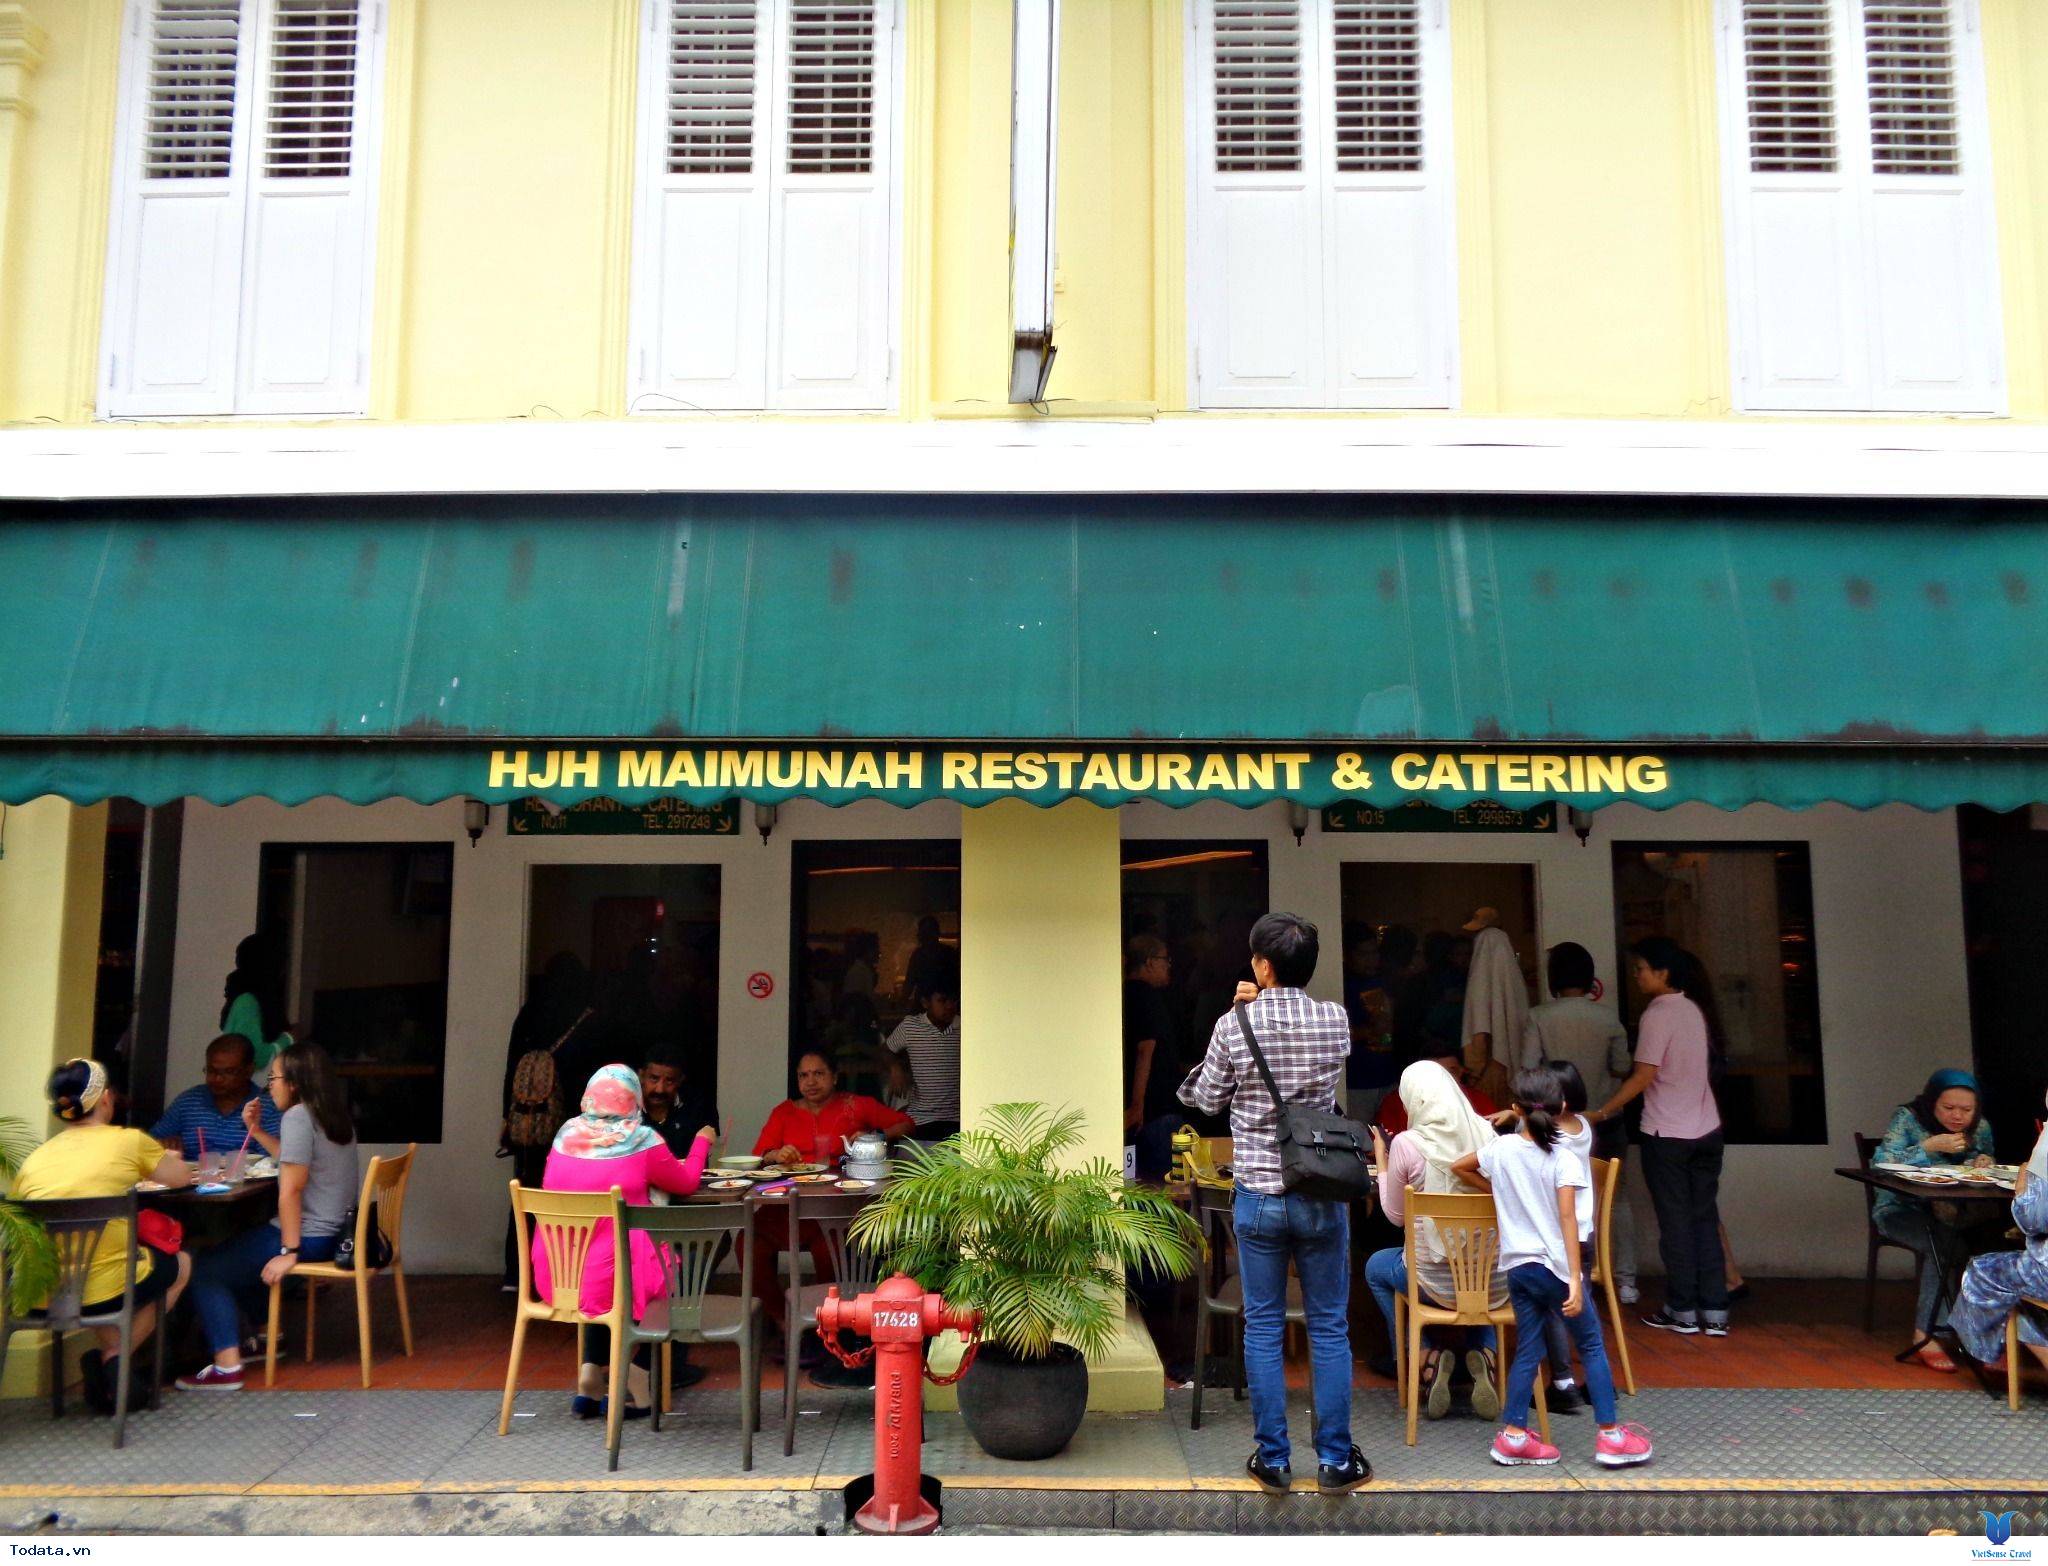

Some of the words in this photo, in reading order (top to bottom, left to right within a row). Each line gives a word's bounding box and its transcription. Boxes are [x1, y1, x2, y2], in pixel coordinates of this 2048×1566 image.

[488, 750, 599, 788] HJH
[617, 750, 923, 789] MAIMUNAH
[942, 752, 1310, 791] RESTAURANT
[1331, 753, 1373, 791] &
[1391, 753, 1668, 793] CATERING
[1126, 1152, 1133, 1168] 9
[873, 1311, 918, 1327] 17628
